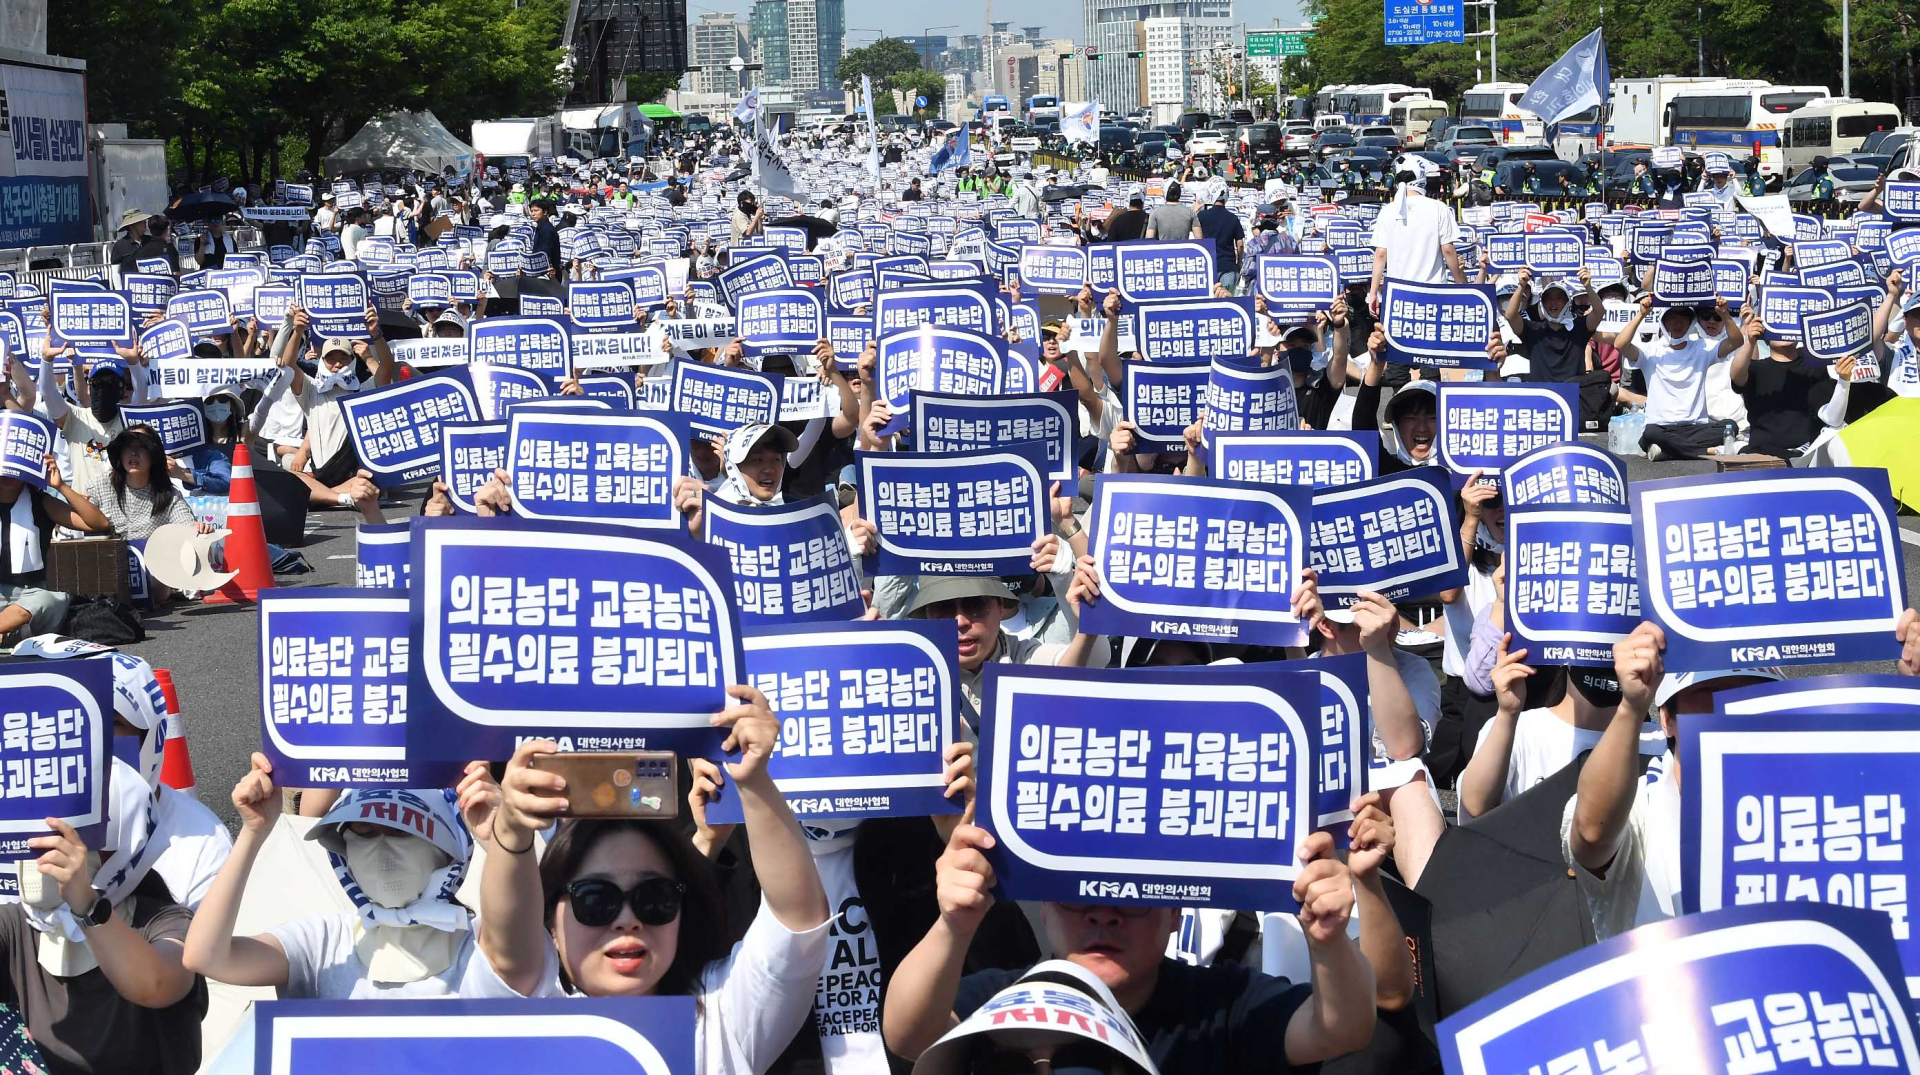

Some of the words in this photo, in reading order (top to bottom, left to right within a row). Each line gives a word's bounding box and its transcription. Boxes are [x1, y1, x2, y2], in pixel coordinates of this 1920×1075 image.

[12, 116, 49, 160] 의사들이
[755, 261, 781, 277] 교육농단
[1056, 257, 1083, 269] 교육농단
[1124, 258, 1164, 275] 의료농단
[1166, 256, 1206, 273] 교육농단
[1266, 266, 1298, 280] 의료농단
[1300, 266, 1331, 280] 교육농단
[306, 283, 332, 296] 의료농단
[334, 283, 361, 296] 교육농단
[635, 286, 661, 298] 붕괴된다
[1124, 276, 1165, 292] 필수의료
[1168, 274, 1207, 290] 붕괴된다
[1266, 279, 1298, 293] 필수의료
[1300, 280, 1332, 293] 붕괴된다
[59, 303, 89, 316] 의료농단
[92, 303, 124, 316] 교육농단
[307, 296, 332, 310] 필수의료
[334, 296, 362, 310] 붕괴된다
[574, 306, 600, 318] 필수의료
[602, 305, 631, 317] 붕괴된다
[742, 304, 776, 318] 의료농단
[780, 302, 816, 318] 교육농단
[1392, 300, 1437, 321] 의료농단
[1441, 305, 1486, 322] 교육농단
[1767, 298, 1798, 312] 의료농단
[1800, 297, 1829, 311] 교육농단
[59, 317, 90, 330] 필수의료
[93, 316, 124, 330] 붕괴된다
[743, 319, 777, 335] 필수의료
[780, 319, 817, 334] 붕괴된다
[883, 308, 930, 328] 의료농단
[934, 306, 982, 326] 교육농단
[1148, 320, 1194, 338] 의료농단
[1197, 318, 1243, 337] 교육농단
[1766, 310, 1798, 325] 필수의료
[1810, 323, 1843, 338] 의료농단
[1845, 314, 1868, 331] 교육농단
[477, 336, 516, 350] 의료농단
[519, 333, 562, 350] 교육농단
[1391, 320, 1436, 341] 필수의료
[1440, 325, 1487, 342] 붕괴된다
[1812, 335, 1845, 350] 필수의료
[1846, 327, 1870, 343] 붕괴된다
[1149, 339, 1196, 358] 필수의료
[1198, 338, 1244, 356] 붕괴된다
[519, 353, 563, 368] 붕괴된다
[940, 349, 994, 373] 교육농단
[1413, 357, 1434, 365] KMA
[939, 372, 992, 394] 붕괴된다
[1138, 385, 1191, 403] 의료농단
[682, 381, 725, 402] 의료농단
[727, 387, 771, 408] 교육농단
[1250, 391, 1295, 413] 교육농단
[358, 409, 408, 438] 의료농단
[411, 391, 464, 421] 교육농단
[681, 398, 722, 419] 필수의료
[725, 403, 768, 424] 붕괴된다
[1138, 406, 1192, 426] 필수의료
[1448, 408, 1499, 430] 의료농단
[1502, 408, 1562, 432] 교육농단
[6, 428, 47, 448] 교육농단
[928, 416, 992, 439] 의료농단
[998, 417, 1061, 441] 교육농단
[5, 442, 44, 464] 붕괴된다
[363, 433, 417, 460] 필수의료
[1448, 432, 1499, 457] 필수의료
[518, 440, 589, 469] 의료농단
[594, 442, 669, 472] 교육농단
[402, 468, 427, 481] KMA
[1228, 459, 1293, 483] 의료농단
[1298, 459, 1362, 482] 교육농단
[518, 471, 590, 501] 필수의료
[595, 477, 669, 505] 붕괴된다
[878, 482, 951, 509] 의료농단
[957, 475, 1029, 508] 교육농단
[1515, 466, 1568, 500] 의료농단
[1573, 465, 1621, 497] 교육농단
[879, 509, 952, 538] 필수의료
[959, 506, 1032, 538] 붕괴된다
[1360, 497, 1435, 539] 교육농단
[1113, 512, 1199, 549] 의료농단
[1204, 518, 1288, 556] 교육농단
[1664, 516, 1771, 564] 의료농단
[1779, 513, 1876, 557] 교육농단
[789, 530, 849, 576] 교육농단
[1368, 527, 1442, 568] 붕괴된다
[1519, 541, 1582, 576] 의료농단
[921, 562, 954, 572] KMA
[1109, 549, 1196, 589] 필수의료
[1203, 557, 1289, 593] 붕괴된다
[792, 567, 860, 613] 붕괴된다
[1668, 564, 1776, 610] 필수의료
[1784, 558, 1885, 601] 붕괴된다
[448, 574, 580, 629] 의료농단
[590, 578, 712, 634] 교육농단
[1517, 579, 1580, 617] 필수의료
[1150, 620, 1192, 635] KMA
[1192, 623, 1239, 634] 대한의사협회
[271, 636, 354, 678] 의료농단
[448, 632, 579, 686] 필수의료
[591, 635, 718, 688] 붕괴된다
[1543, 647, 1576, 661] KMA
[1731, 646, 1780, 663] KMA
[1781, 642, 1836, 656] 대한의사협회
[839, 667, 936, 710] 교육농단
[272, 684, 353, 725] 필수의료
[577, 736, 646, 750] 대한의사협회
[842, 713, 939, 756] 붕괴된다
[1016, 723, 1151, 780] 의료농단
[1160, 731, 1290, 783] 교육농단
[309, 767, 351, 783] KMA
[351, 768, 408, 778] 대한의사협회
[835, 797, 889, 807] 대한의사협회
[1016, 781, 1147, 835] 필수의료
[1159, 788, 1290, 841] 붕괴된다
[359, 802, 434, 840] 저지
[1732, 795, 1905, 863] 의료농단
[1079, 880, 1139, 899] KMA
[1141, 883, 1212, 896] 대한의사협회
[990, 1007, 1108, 1042] 저지
[1711, 991, 1899, 1075] 교육농단
